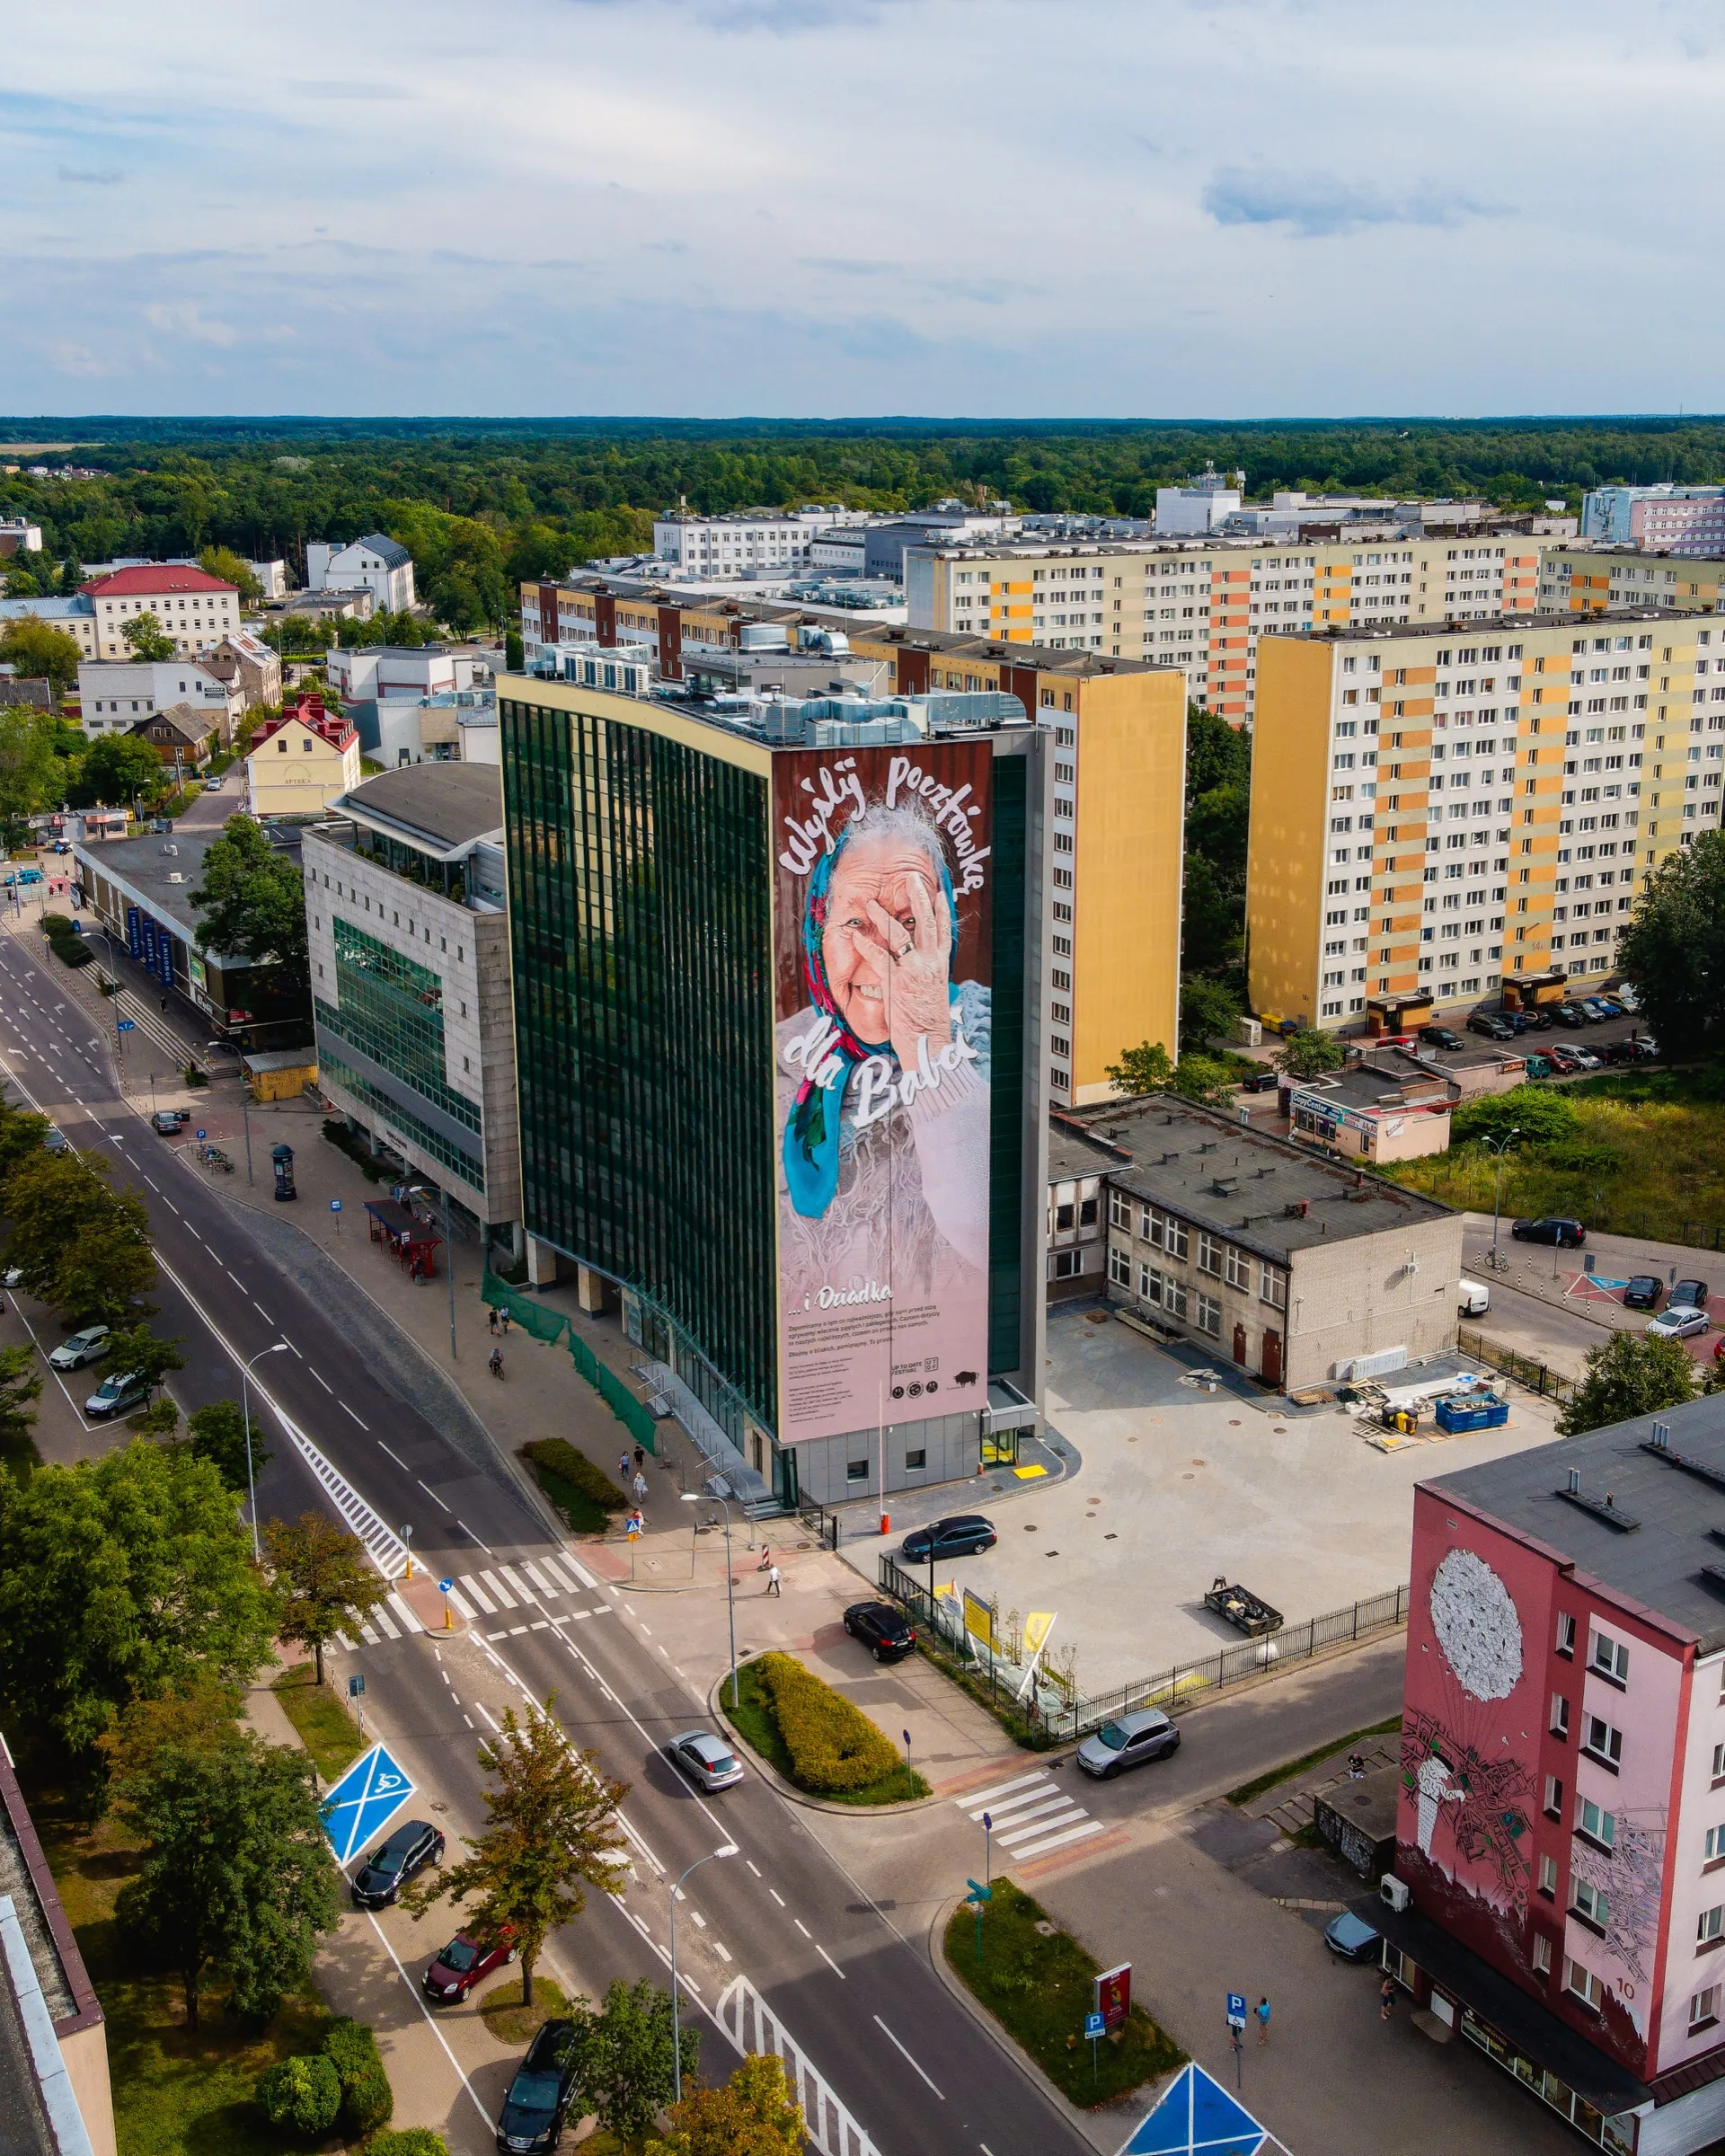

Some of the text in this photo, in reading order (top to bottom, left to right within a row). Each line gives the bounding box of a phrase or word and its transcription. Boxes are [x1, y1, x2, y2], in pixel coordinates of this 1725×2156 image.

[779, 756, 866, 876] Wyślij
[162, 943, 171, 981] DOWOZIMY
[783, 1005, 979, 1129] dla Babci
[1293, 1093, 1327, 1114] CopyCenter
[199, 1130, 205, 1138] P
[814, 1279, 894, 1311] Dziadka
[1616, 1977, 1634, 2000] 10
[1232, 1995, 1242, 2010] P
[1090, 2015, 1101, 2029] P
